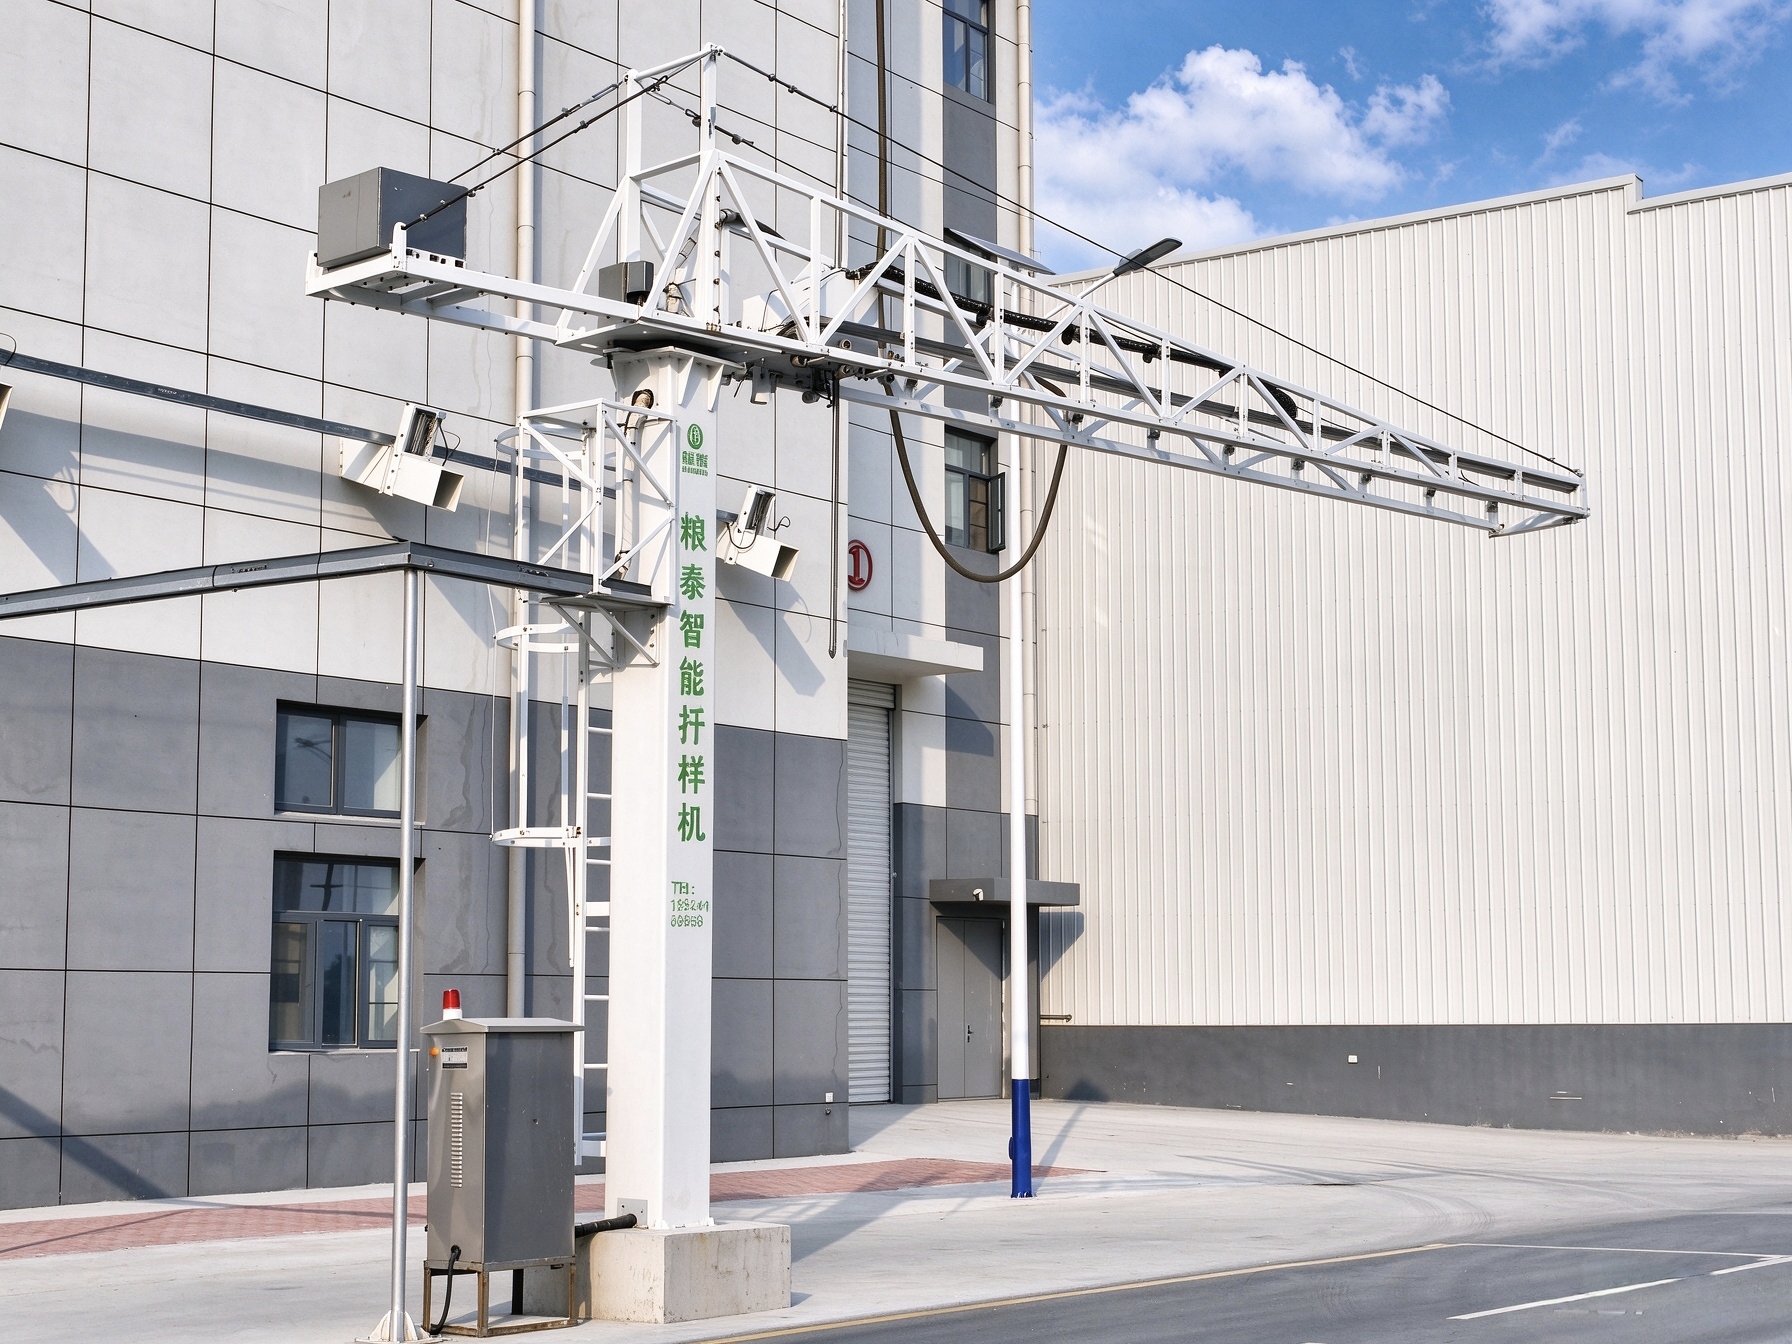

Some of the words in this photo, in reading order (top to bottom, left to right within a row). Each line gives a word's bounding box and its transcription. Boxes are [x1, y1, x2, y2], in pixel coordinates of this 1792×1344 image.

[677, 511, 707, 842] 粮泰智能扦样机
